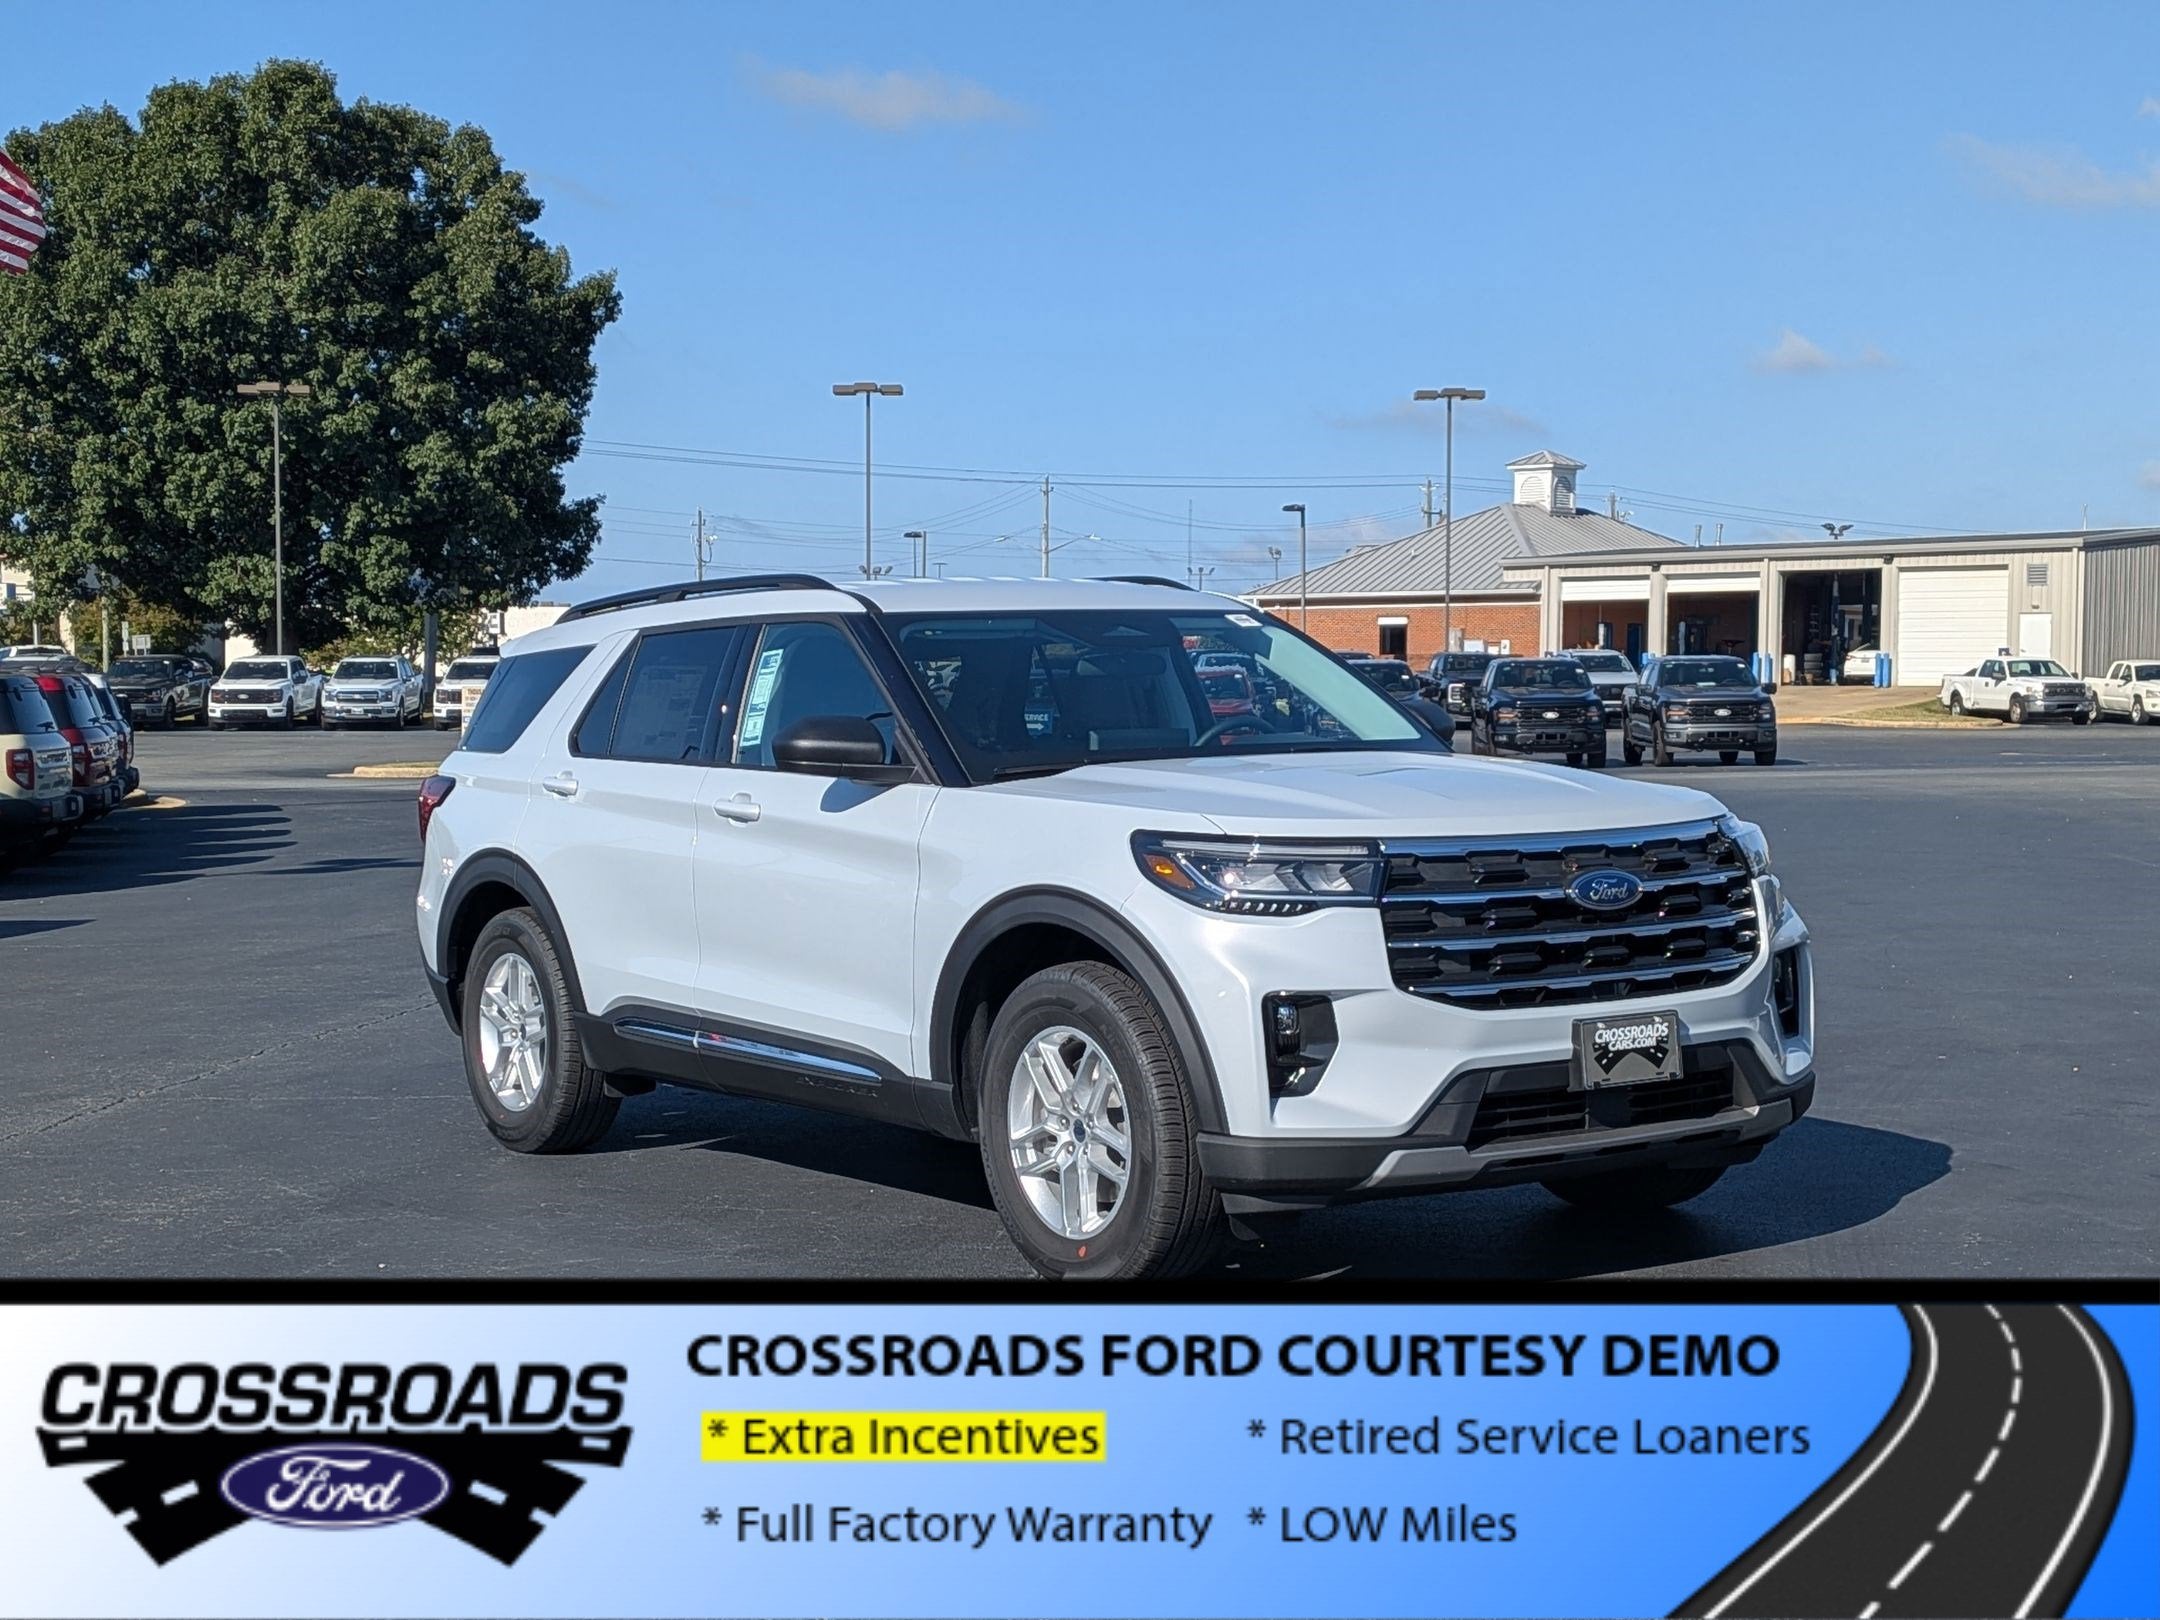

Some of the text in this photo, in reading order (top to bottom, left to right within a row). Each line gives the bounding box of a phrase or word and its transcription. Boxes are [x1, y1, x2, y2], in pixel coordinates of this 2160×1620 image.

[1589, 878, 1629, 900] Ford
[1594, 1021, 1670, 1044] CROSSROADS
[1607, 1036, 1657, 1052] CARS.COM
